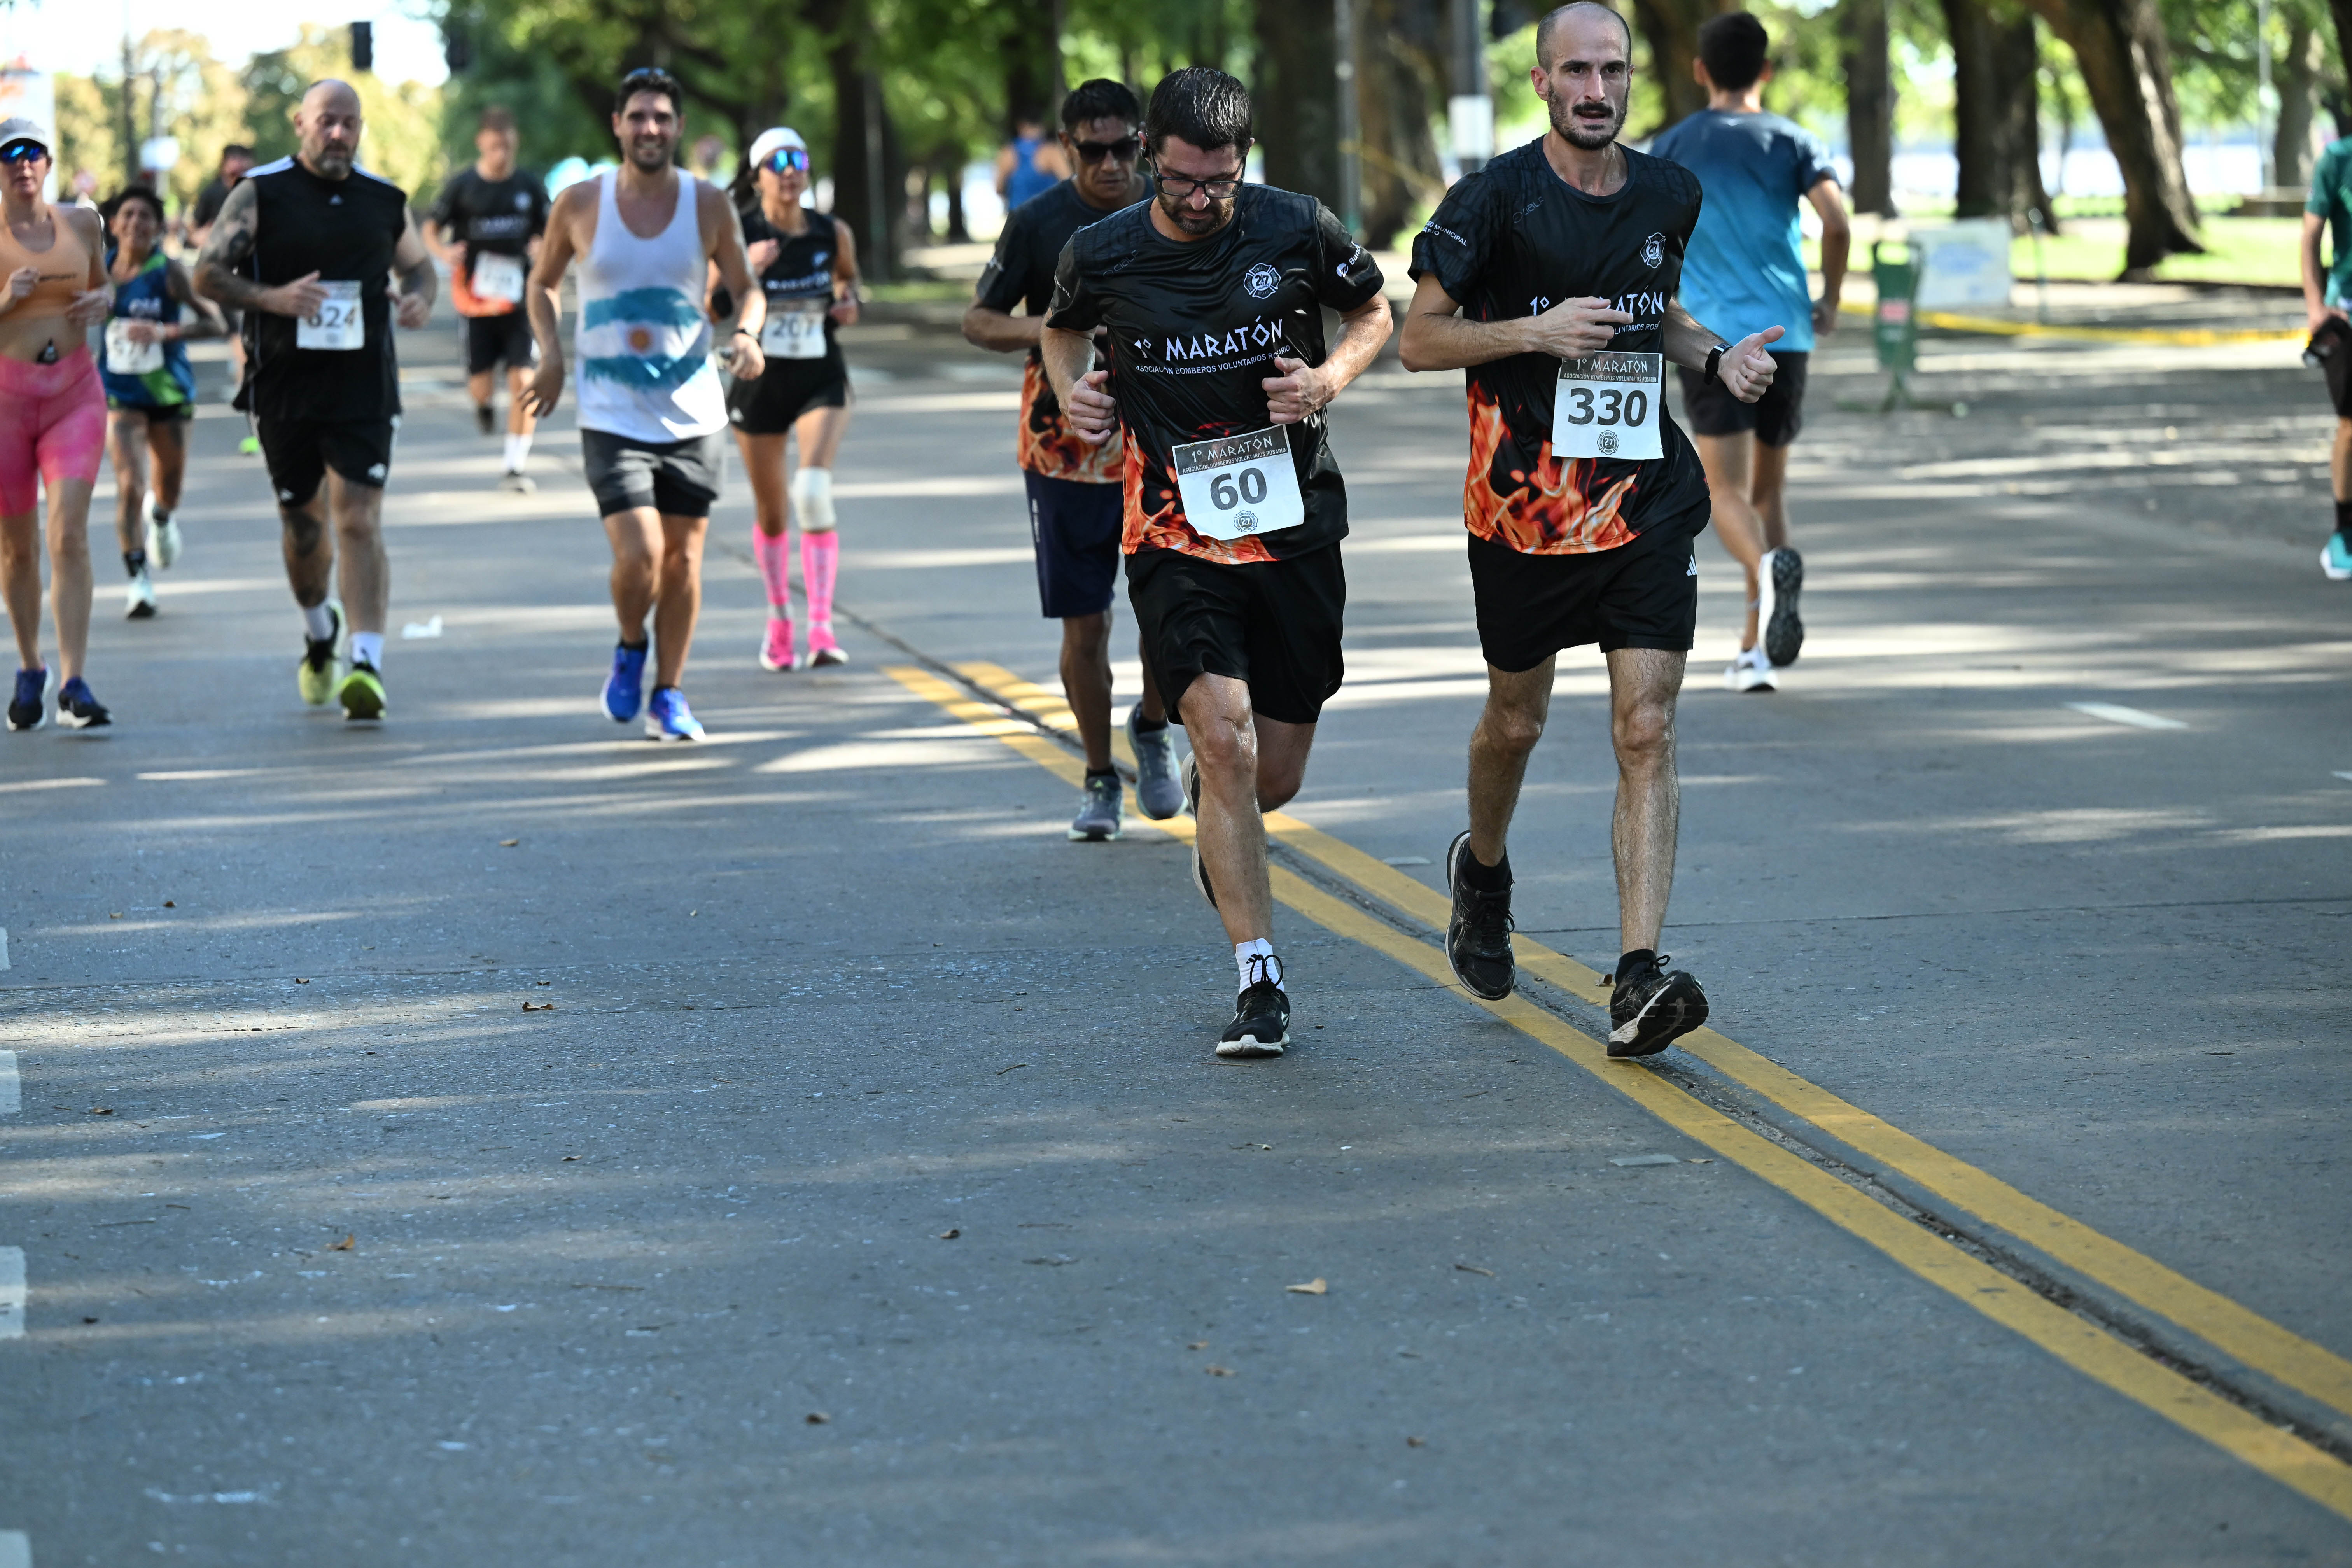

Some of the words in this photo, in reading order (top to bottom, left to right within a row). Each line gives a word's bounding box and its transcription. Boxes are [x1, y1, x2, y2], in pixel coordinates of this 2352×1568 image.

[1434, 224, 1467, 246] MUNICIPAL
[1255, 275, 1269, 287] 27
[1166, 315, 1283, 361] MARATÓN
[1175, 366, 1217, 375] BOMBEROS
[1218, 354, 1267, 371] VOLUNTARIOS
[1591, 356, 1648, 373] MARATÓN
[1568, 387, 1647, 427] 330
[1208, 435, 1273, 461] MARATÓN
[1605, 437, 1613, 446] 27
[1210, 458, 1235, 469] BOMBEROS
[1235, 452, 1266, 463] VOLUNTARIOS
[1266, 447, 1286, 456] ROSARIO
[1210, 467, 1267, 511] 60
[1241, 518, 1251, 526] 27
